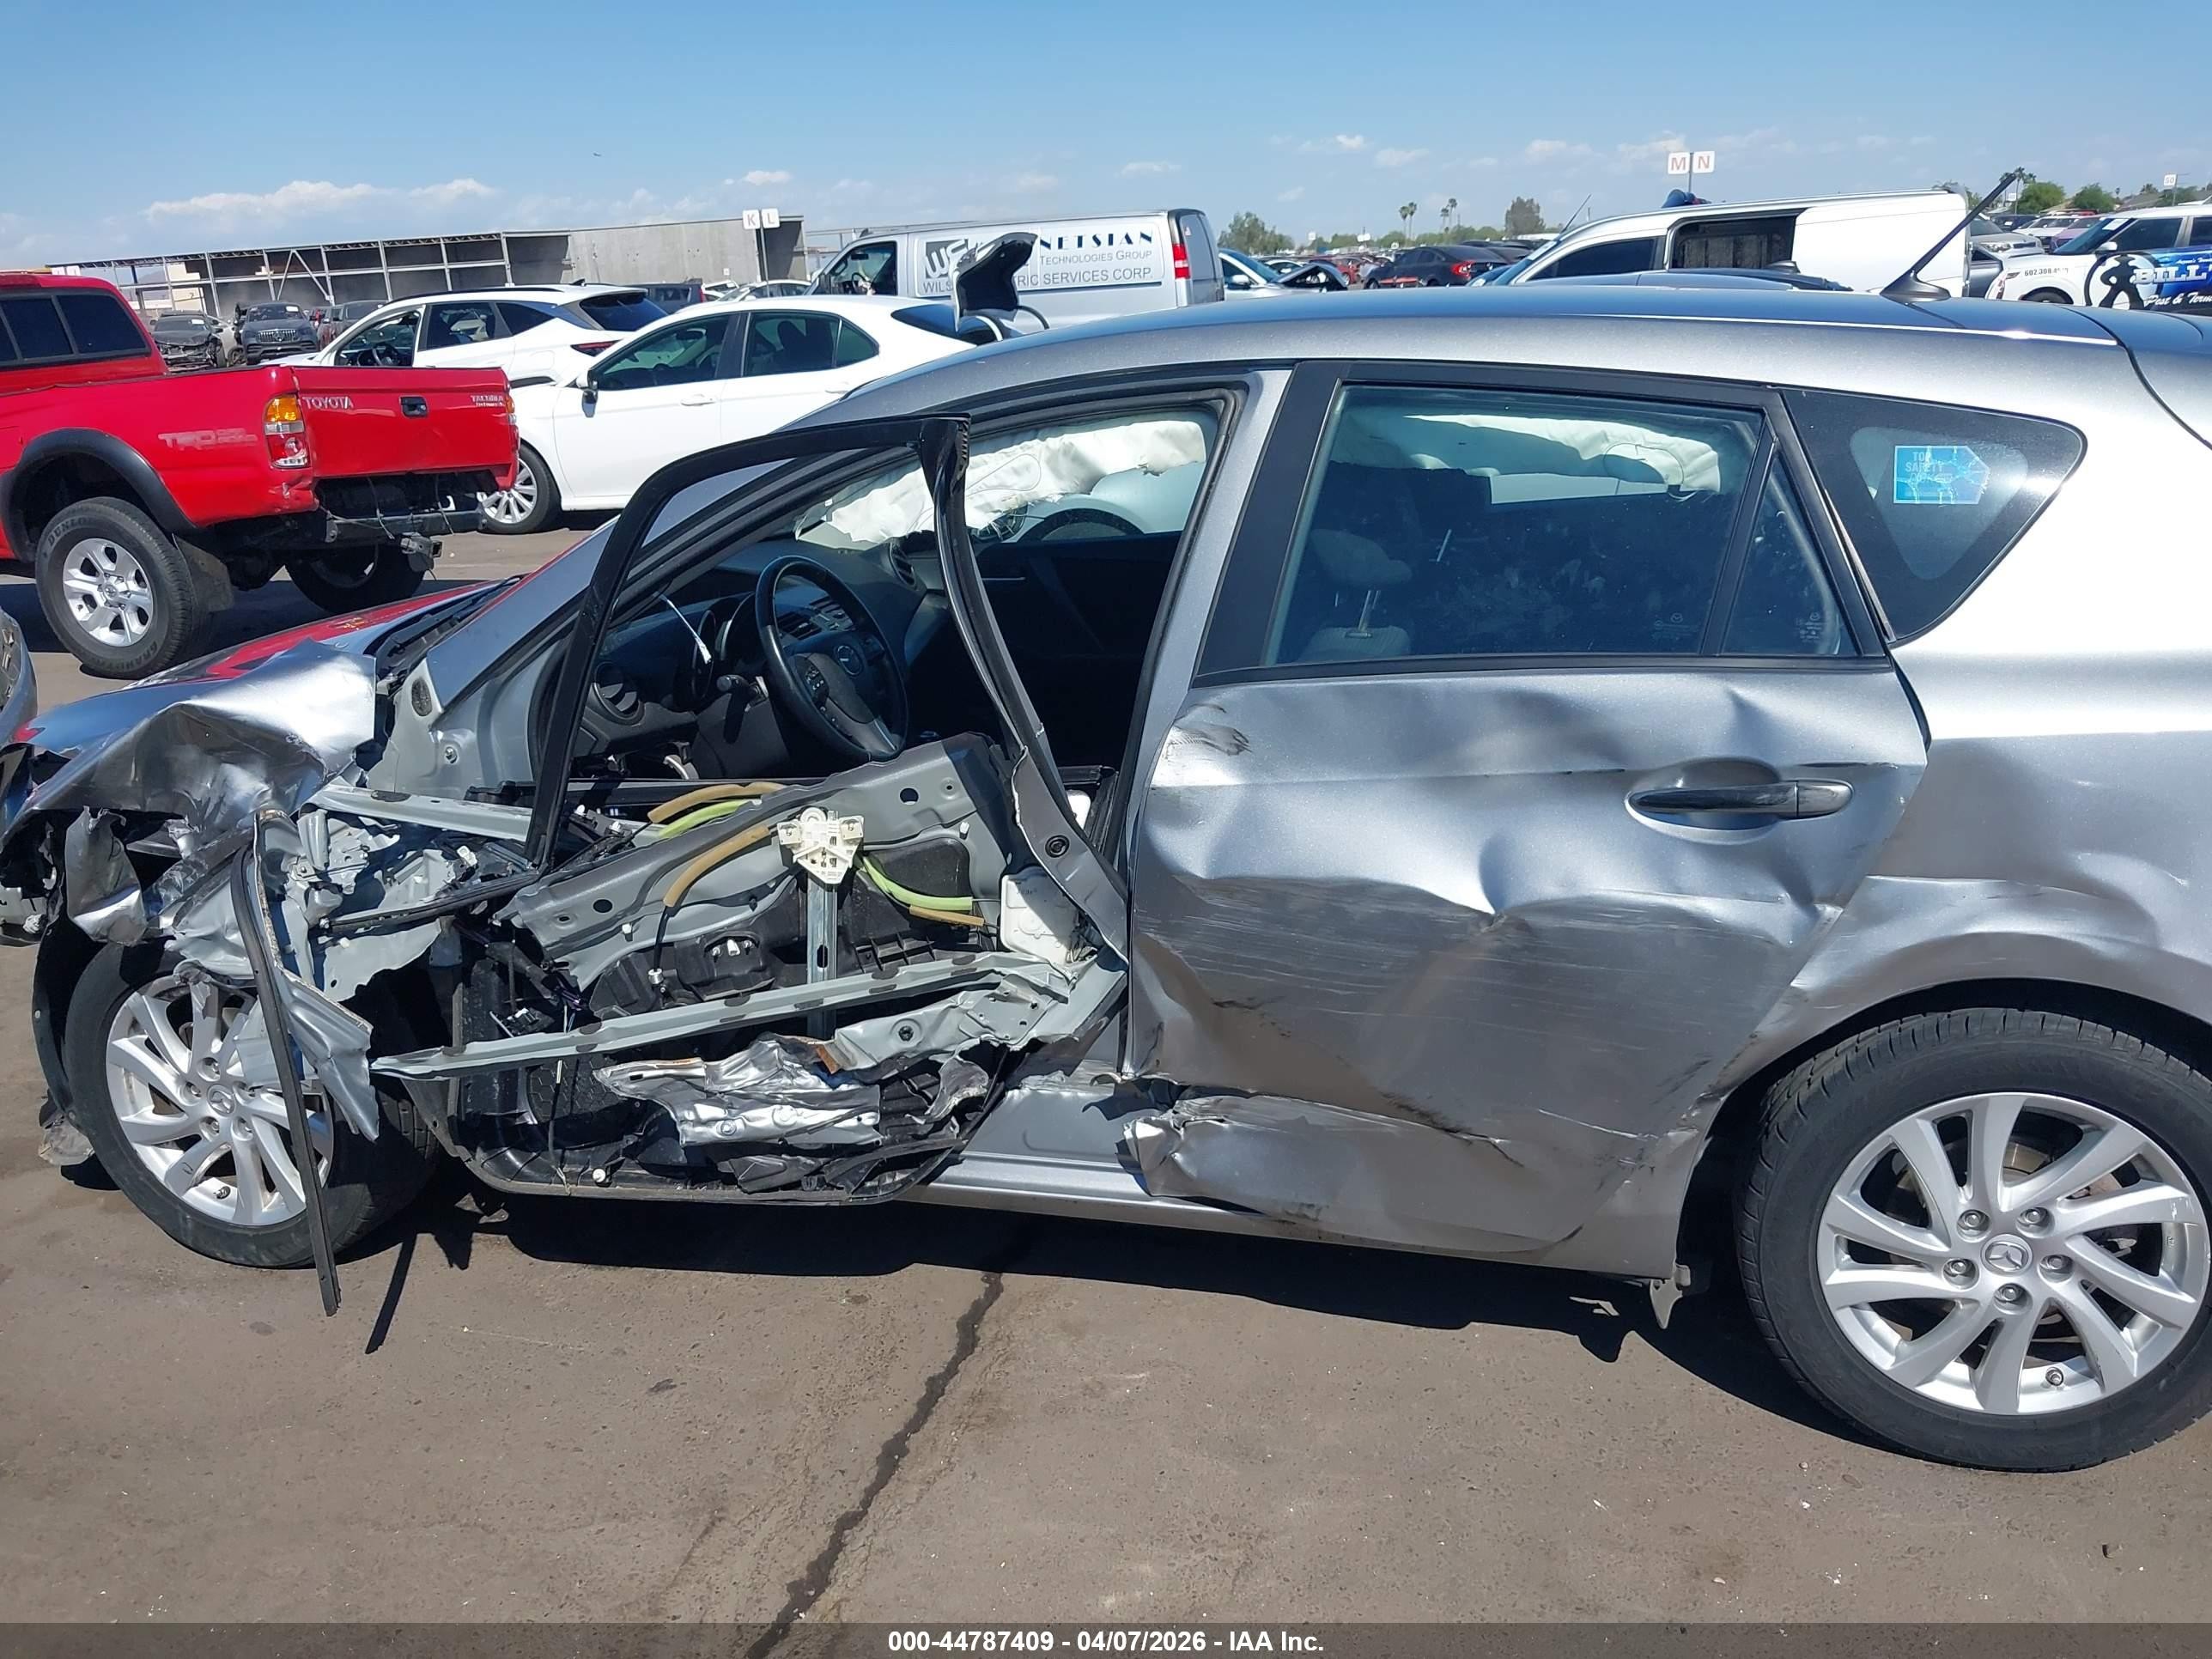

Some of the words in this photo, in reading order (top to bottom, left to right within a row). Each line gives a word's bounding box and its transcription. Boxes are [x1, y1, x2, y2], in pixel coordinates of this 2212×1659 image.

[1671, 157, 1686, 170] M
[1698, 155, 1711, 169] N
[747, 214, 757, 226] K
[767, 213, 775, 224] L
[1040, 230, 1152, 251] NETSIAN
[923, 280, 955, 294] WILS
[1043, 269, 1109, 284] SERVICES
[1113, 267, 1153, 281] CORP.
[302, 396, 355, 410] TOYOTA
